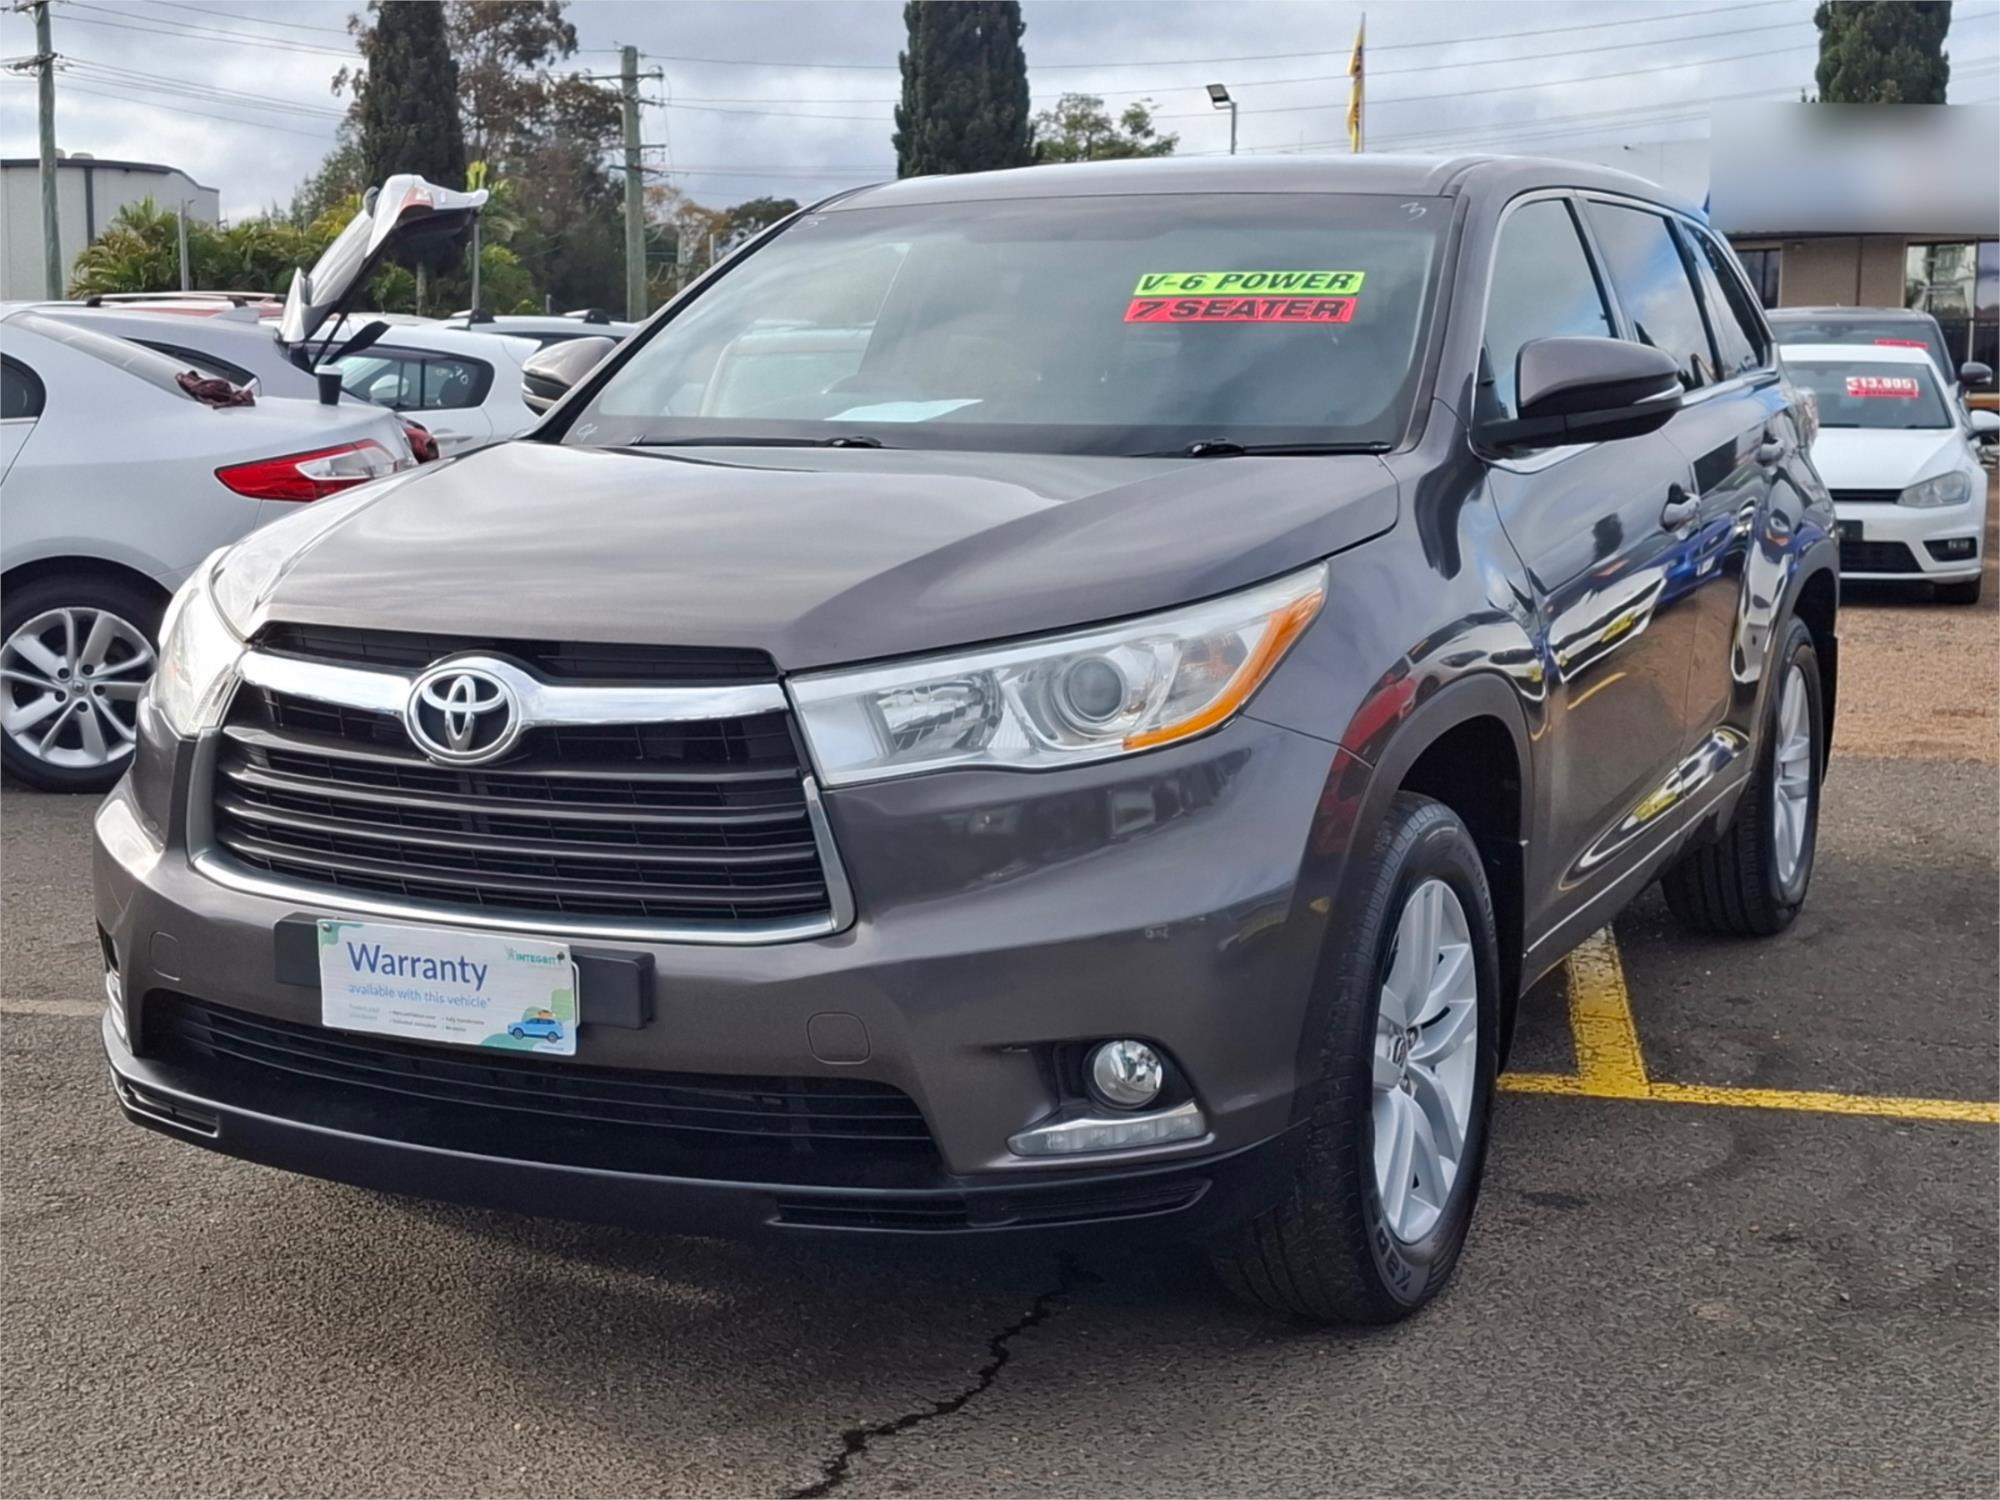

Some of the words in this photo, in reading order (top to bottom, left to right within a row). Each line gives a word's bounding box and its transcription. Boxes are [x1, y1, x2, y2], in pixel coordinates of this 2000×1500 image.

[1141, 274, 1208, 291] V-6
[1214, 273, 1356, 290] POWER
[1132, 301, 1163, 319] 7
[1169, 299, 1349, 319] SEATER
[347, 941, 488, 991] Warranty
[348, 983, 395, 998] available
[396, 989, 422, 1001] with
[424, 991, 445, 1004] this
